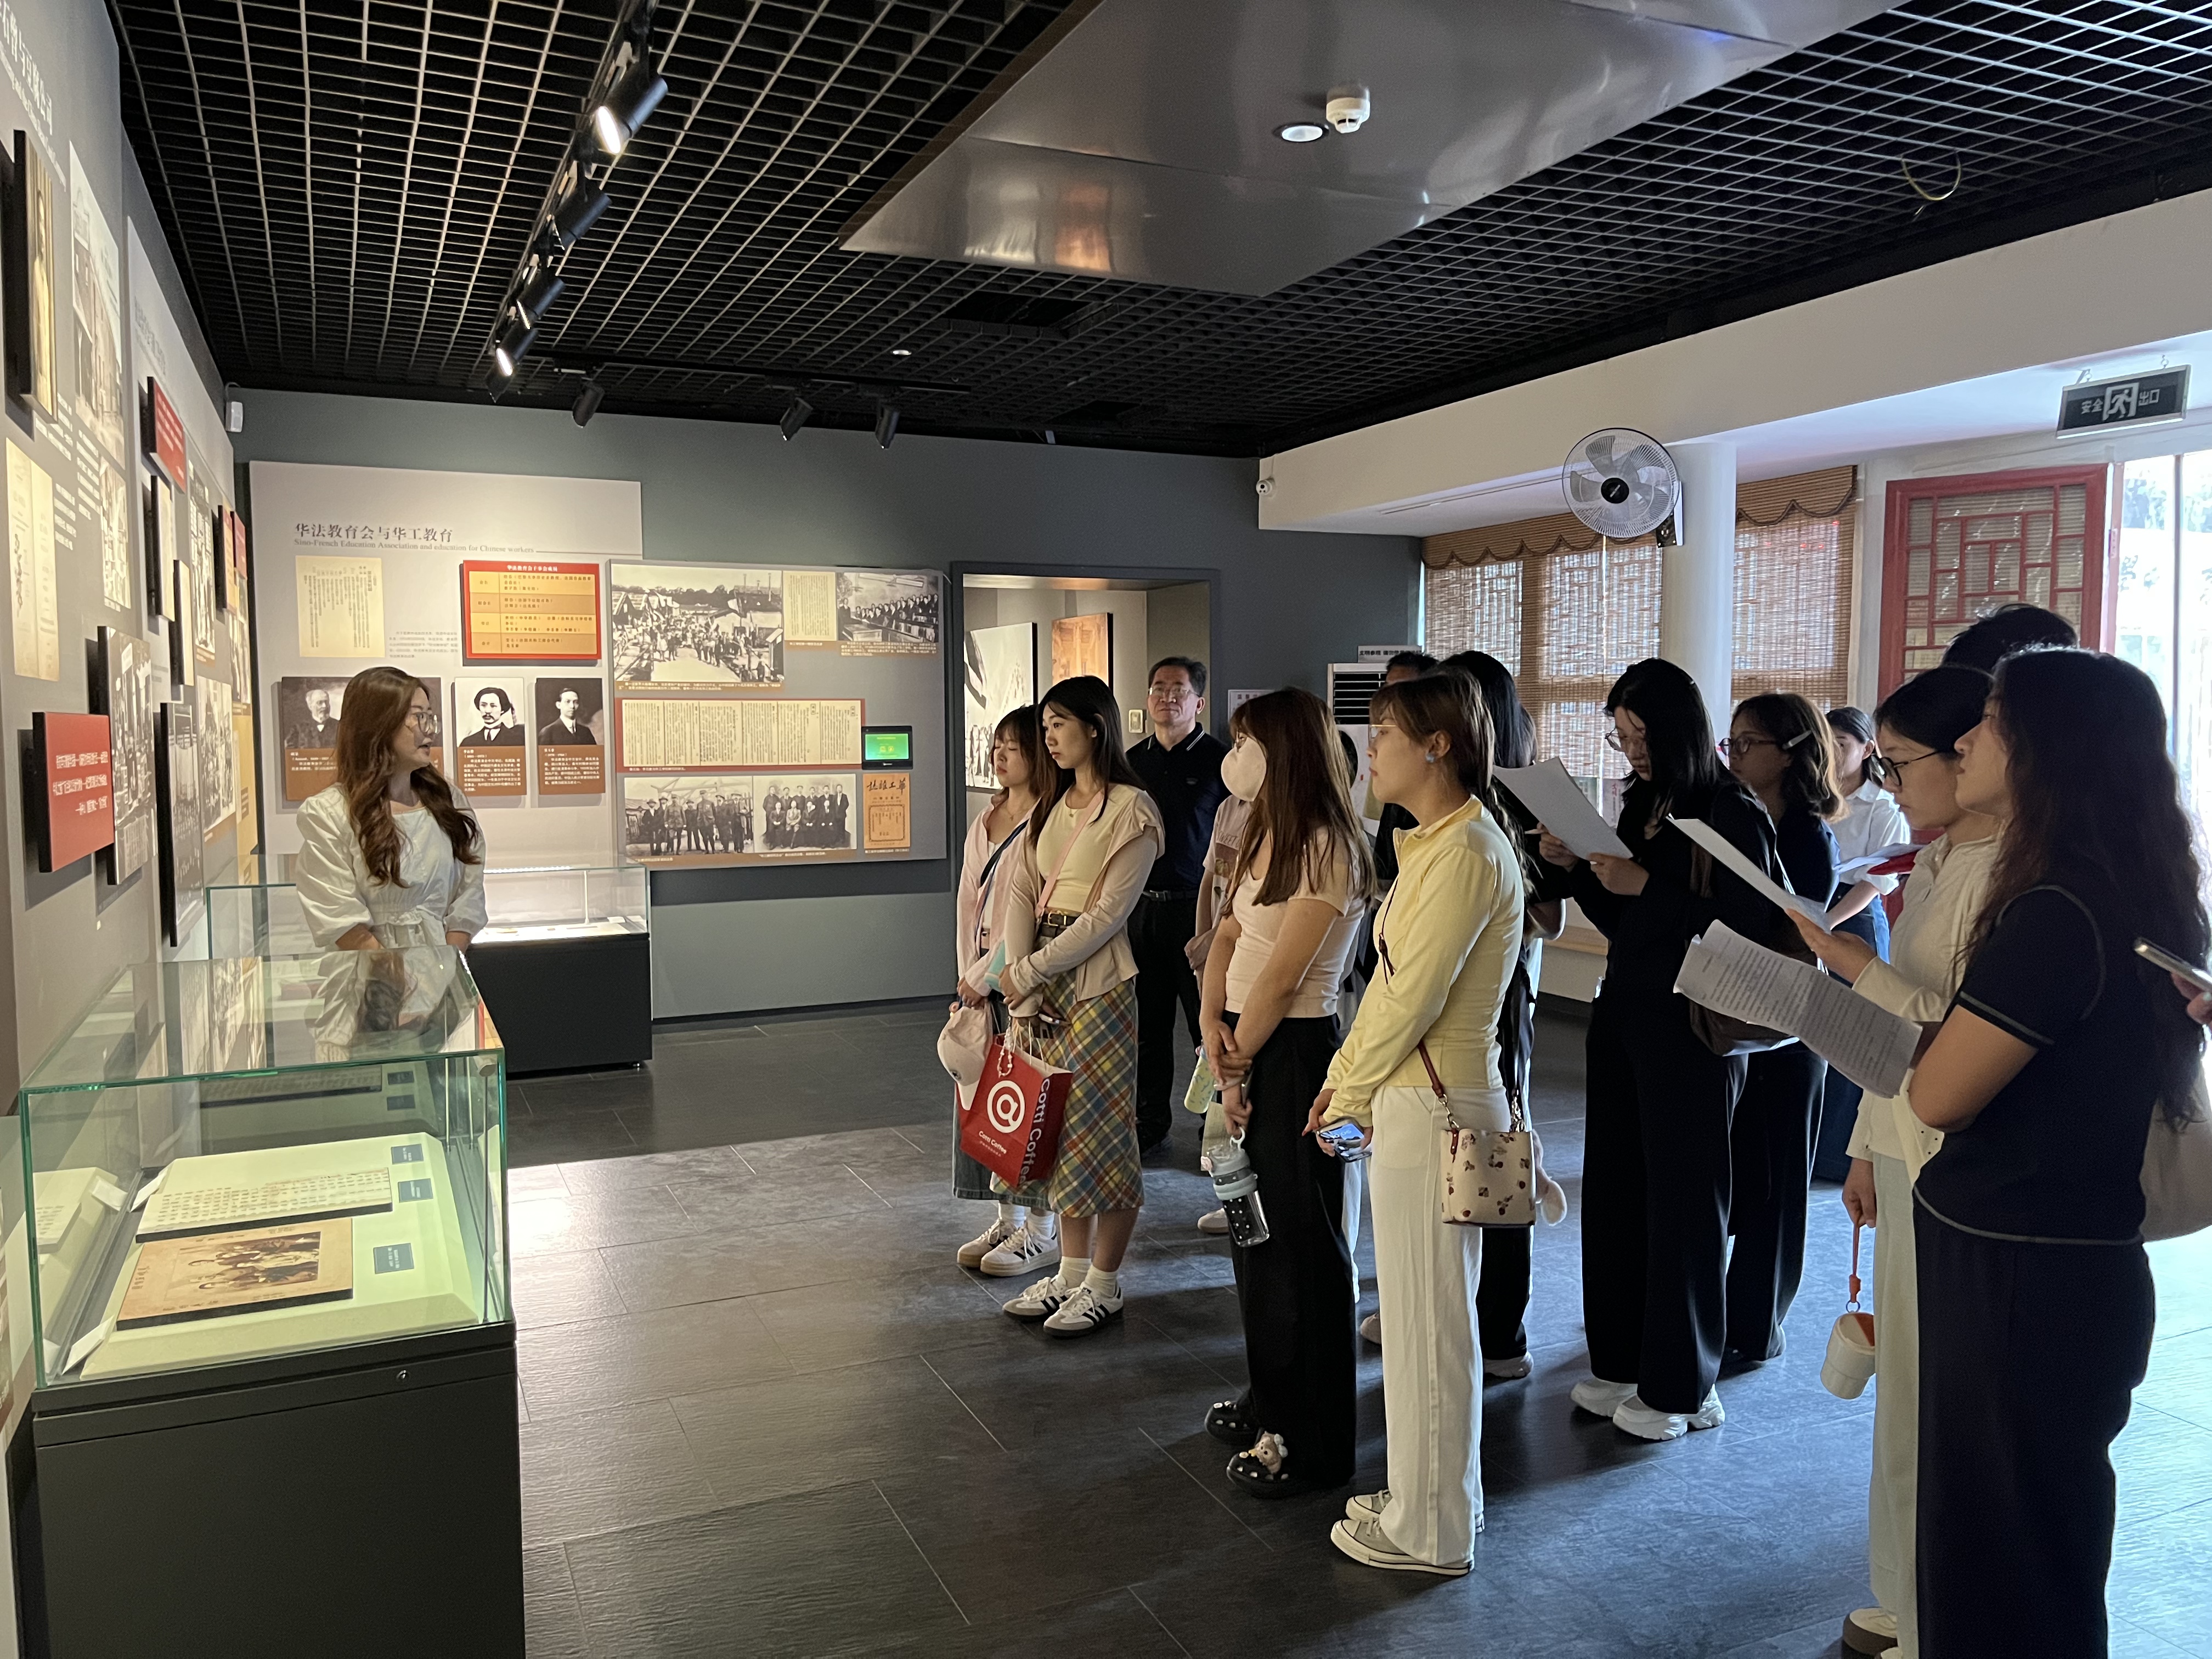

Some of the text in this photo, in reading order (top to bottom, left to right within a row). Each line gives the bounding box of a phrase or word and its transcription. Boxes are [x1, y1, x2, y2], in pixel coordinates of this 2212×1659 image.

[2081, 389, 2160, 414] 安全 出口
[295, 523, 453, 543] 华法教育会与华工教育
[294, 539, 338, 547] Sino-French
[341, 540, 376, 548] Education
[378, 541, 418, 550] Association
[1033, 1078, 1050, 1124] Cotti
